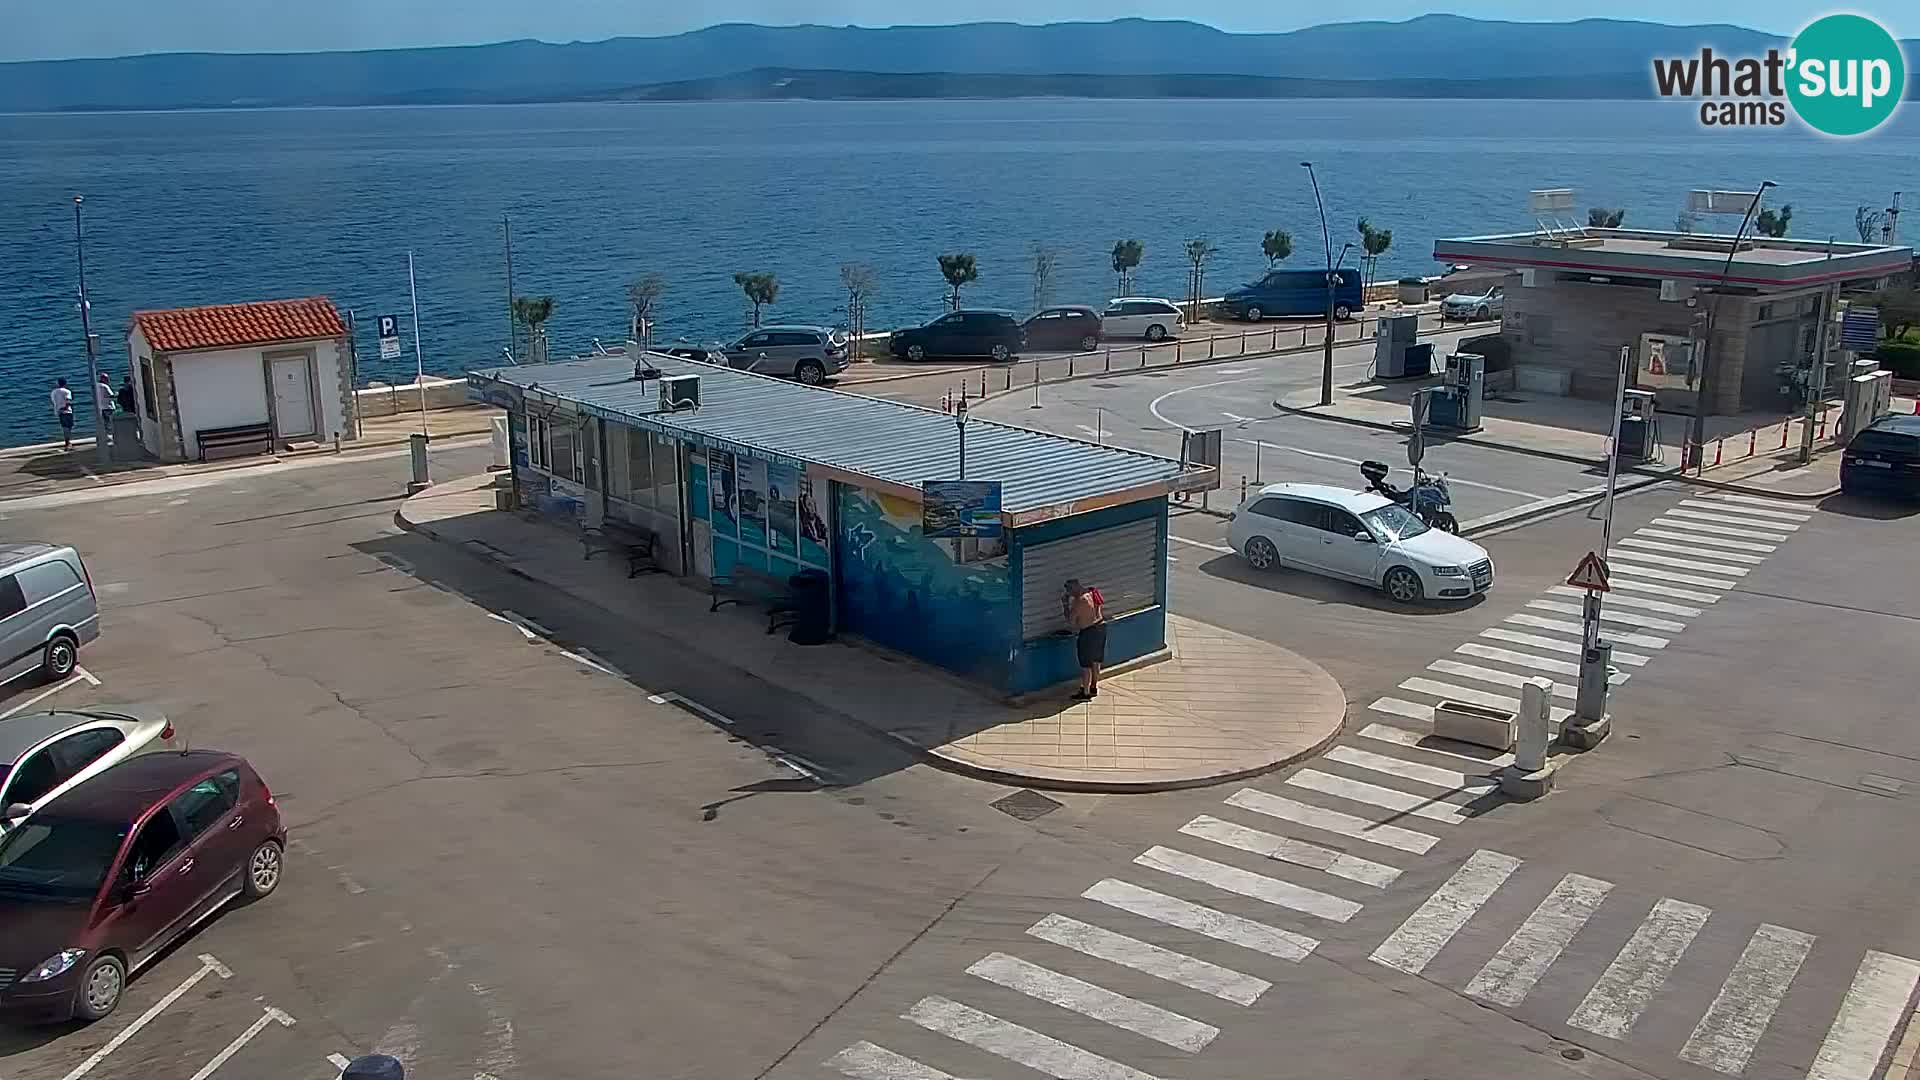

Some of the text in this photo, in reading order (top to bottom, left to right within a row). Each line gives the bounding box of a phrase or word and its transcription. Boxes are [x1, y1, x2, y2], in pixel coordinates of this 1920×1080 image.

[382, 317, 394, 335] P
[719, 441, 749, 456] STATION
[777, 457, 803, 470] OFFICE
